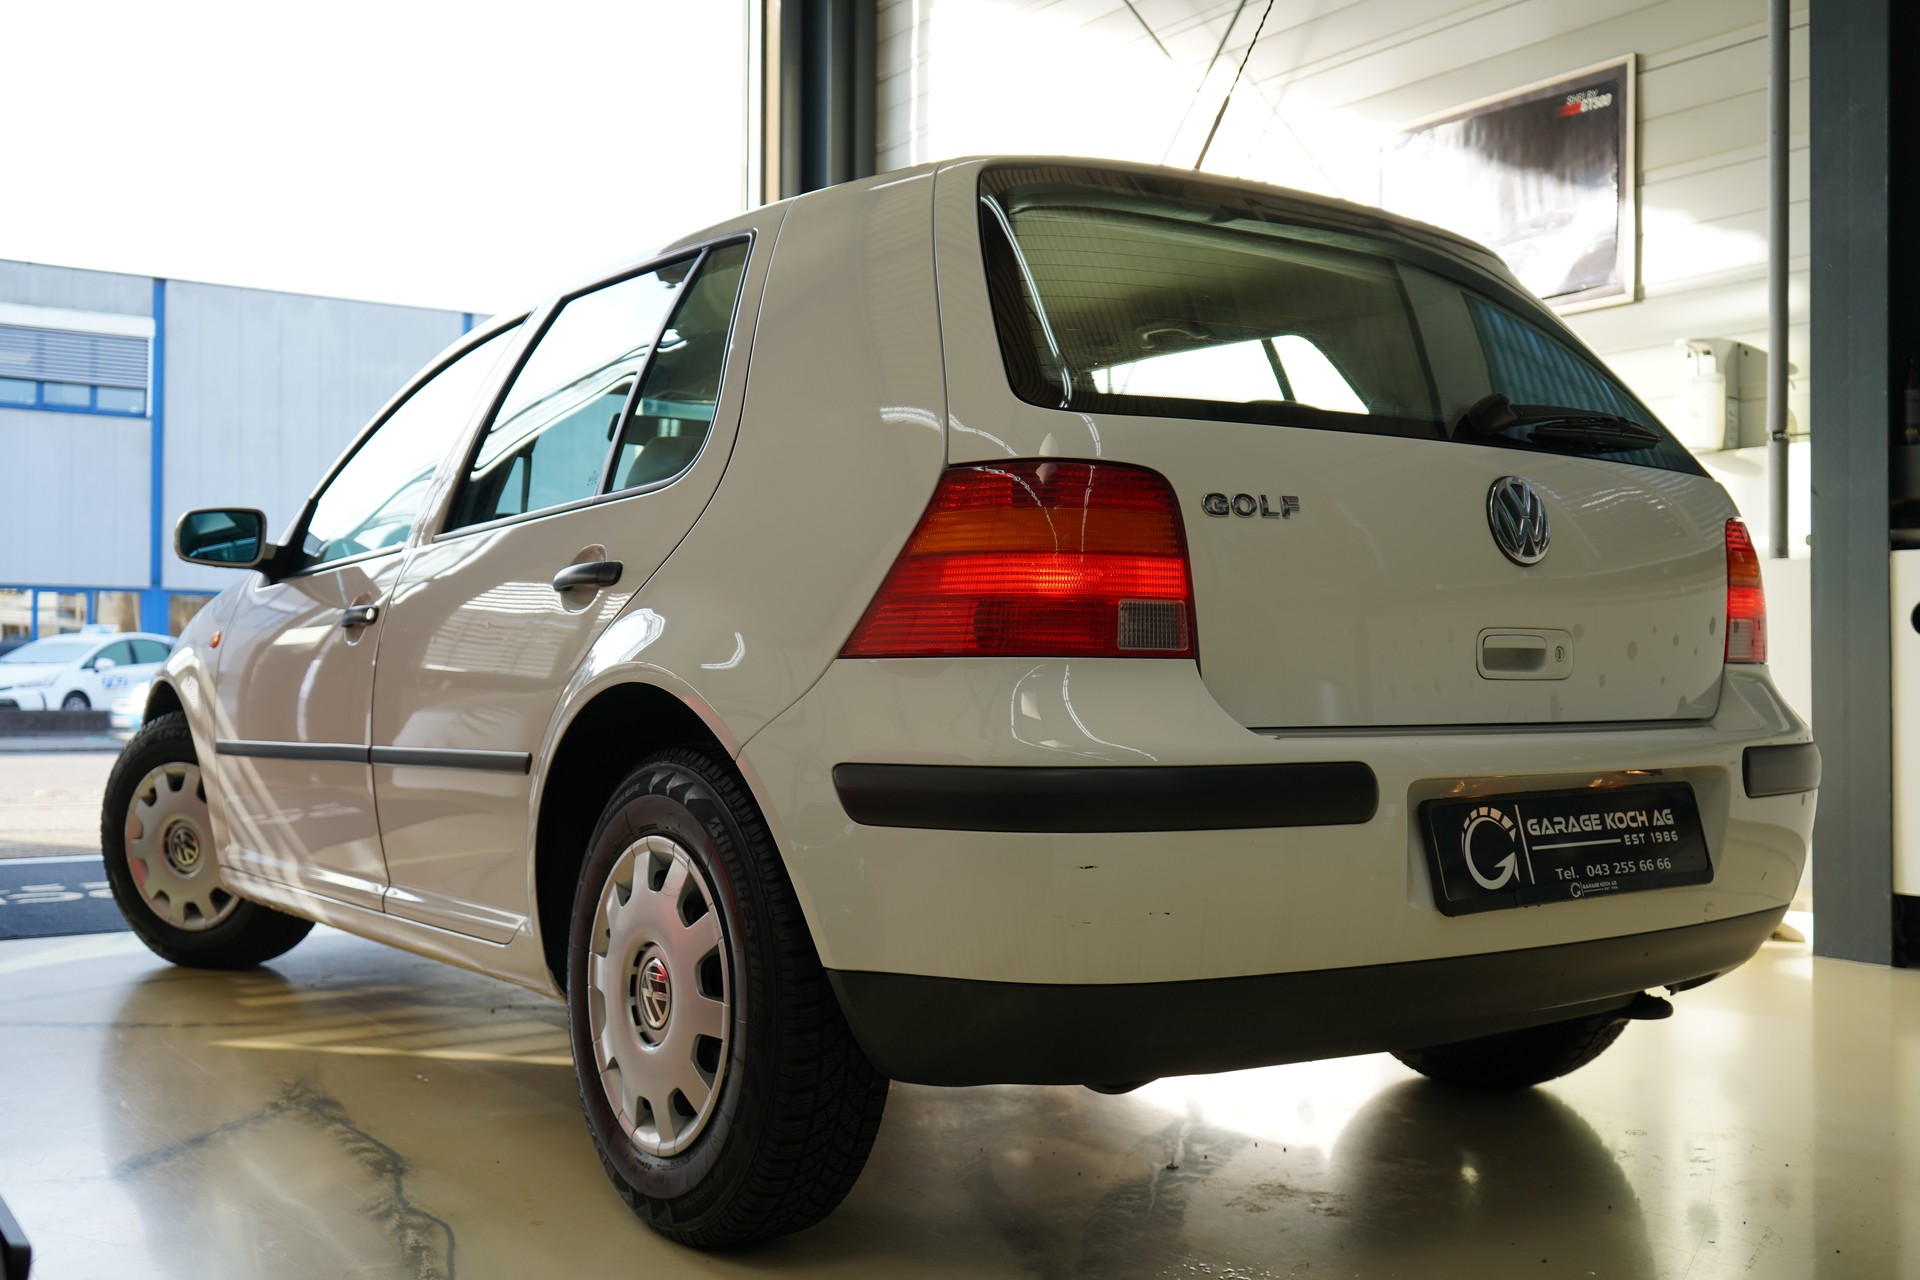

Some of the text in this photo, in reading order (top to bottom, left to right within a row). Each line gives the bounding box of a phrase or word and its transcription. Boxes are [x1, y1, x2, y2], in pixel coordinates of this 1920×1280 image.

[1201, 493, 1300, 519] GOLF
[1527, 808, 1675, 836] GARAGE KOCH AG
[1624, 830, 1679, 845] EST 1986
[1555, 858, 1672, 880] Tel. 043 255 66 66
